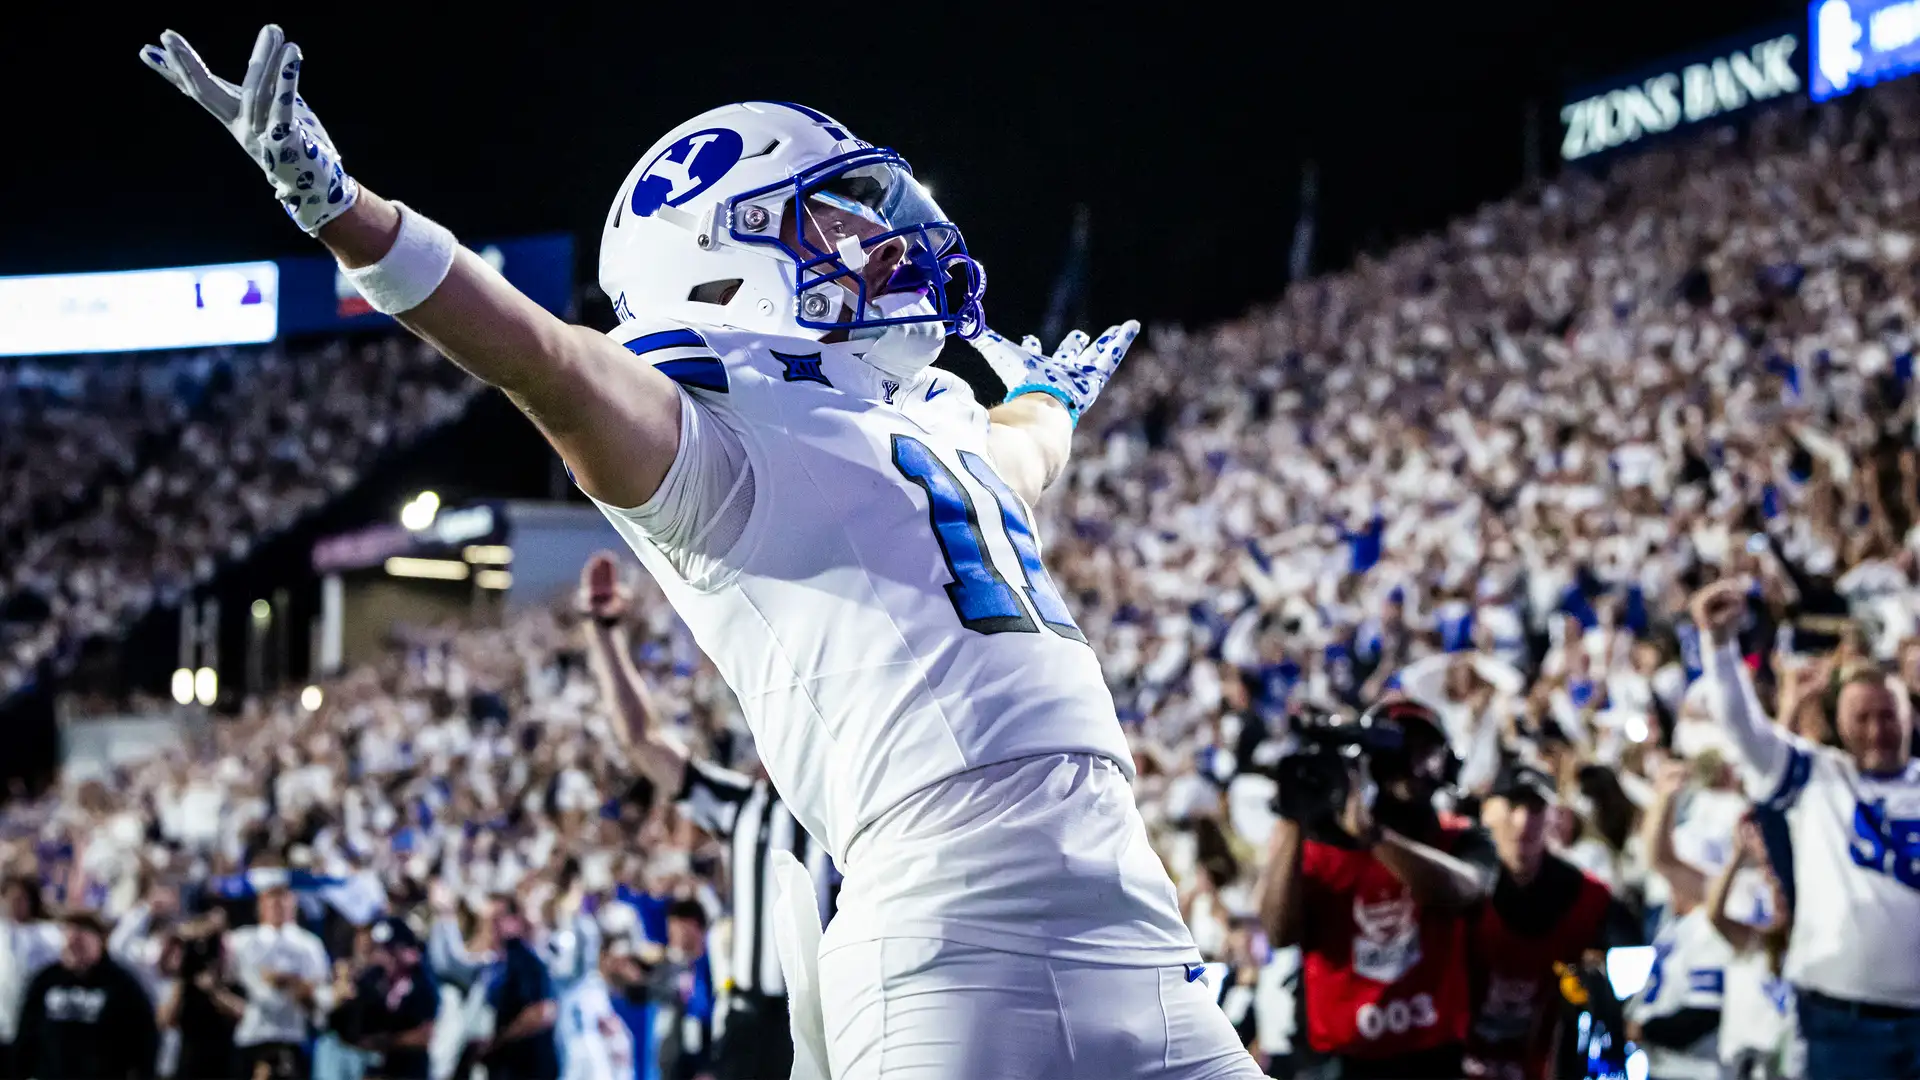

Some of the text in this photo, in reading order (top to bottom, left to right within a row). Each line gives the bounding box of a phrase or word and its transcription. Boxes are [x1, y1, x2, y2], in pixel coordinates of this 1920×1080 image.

[1561, 34, 1800, 160] ZIONS BANK
[642, 133, 719, 203] Y
[882, 380, 899, 405] Y
[890, 433, 1090, 646] 11
[1356, 993, 1438, 1038] 003
